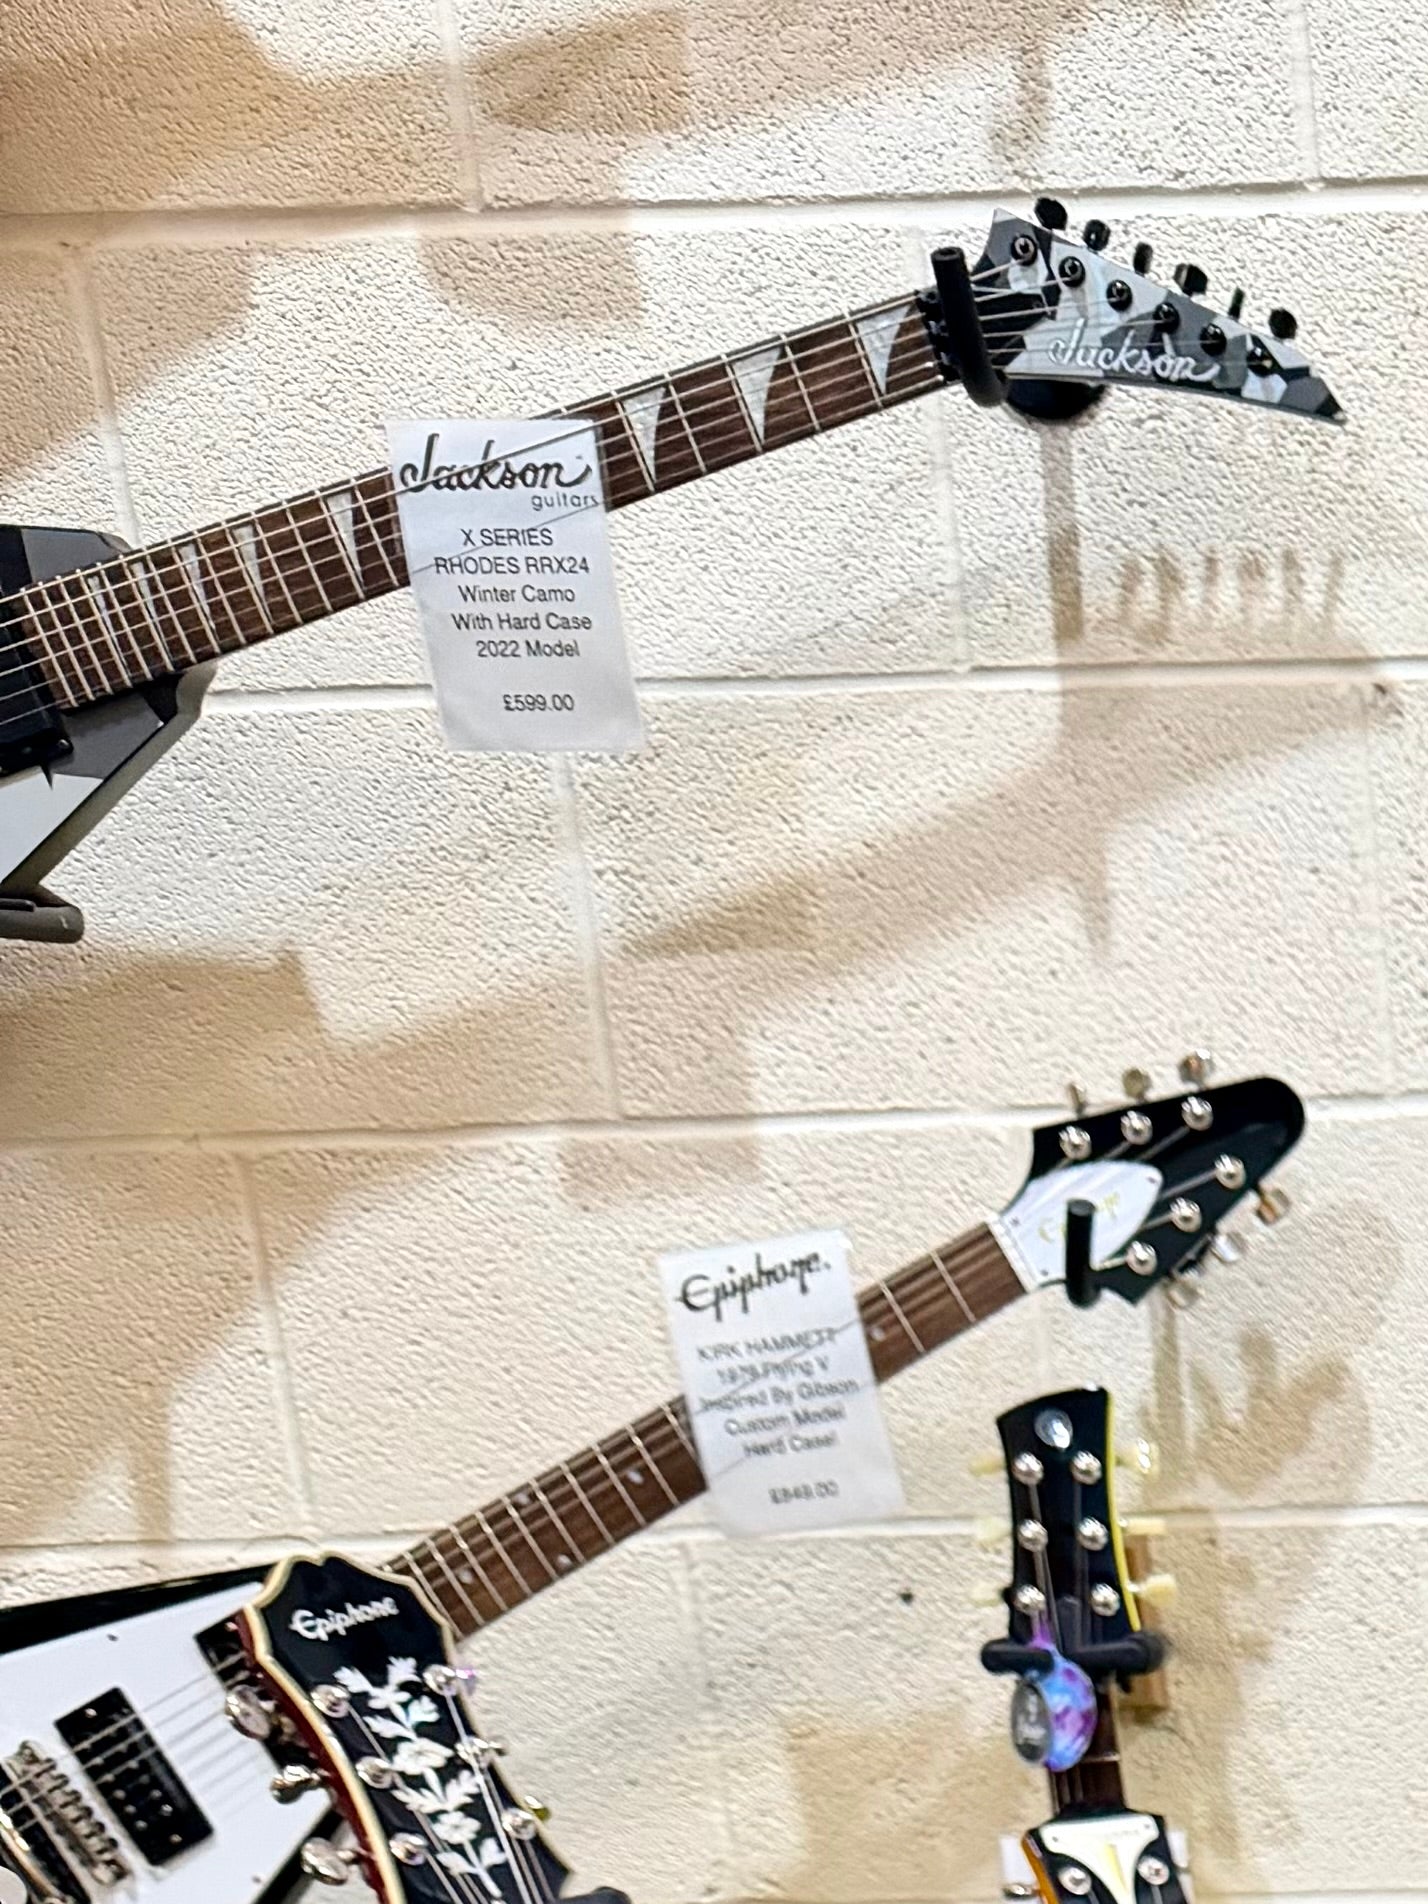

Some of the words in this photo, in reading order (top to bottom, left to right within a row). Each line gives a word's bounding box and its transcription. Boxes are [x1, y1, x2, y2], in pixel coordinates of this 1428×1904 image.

[1048, 318, 1221, 382] Jackson
[400, 433, 593, 493] Jackson
[532, 493, 600, 512] guitars
[462, 529, 477, 546] X
[480, 529, 554, 546] SERIES
[434, 556, 520, 575] RHODES
[526, 556, 590, 575] RRX24
[458, 585, 517, 602] Winter
[521, 585, 576, 602] Camo
[450, 613, 493, 631] With
[499, 613, 541, 630] Hard
[546, 614, 592, 630] Case
[476, 640, 521, 658] 2022
[526, 640, 580, 657] Model
[503, 694, 575, 712] £599.00
[723, 1415, 789, 1437] Custom
[288, 1596, 400, 1641] Epiphone
